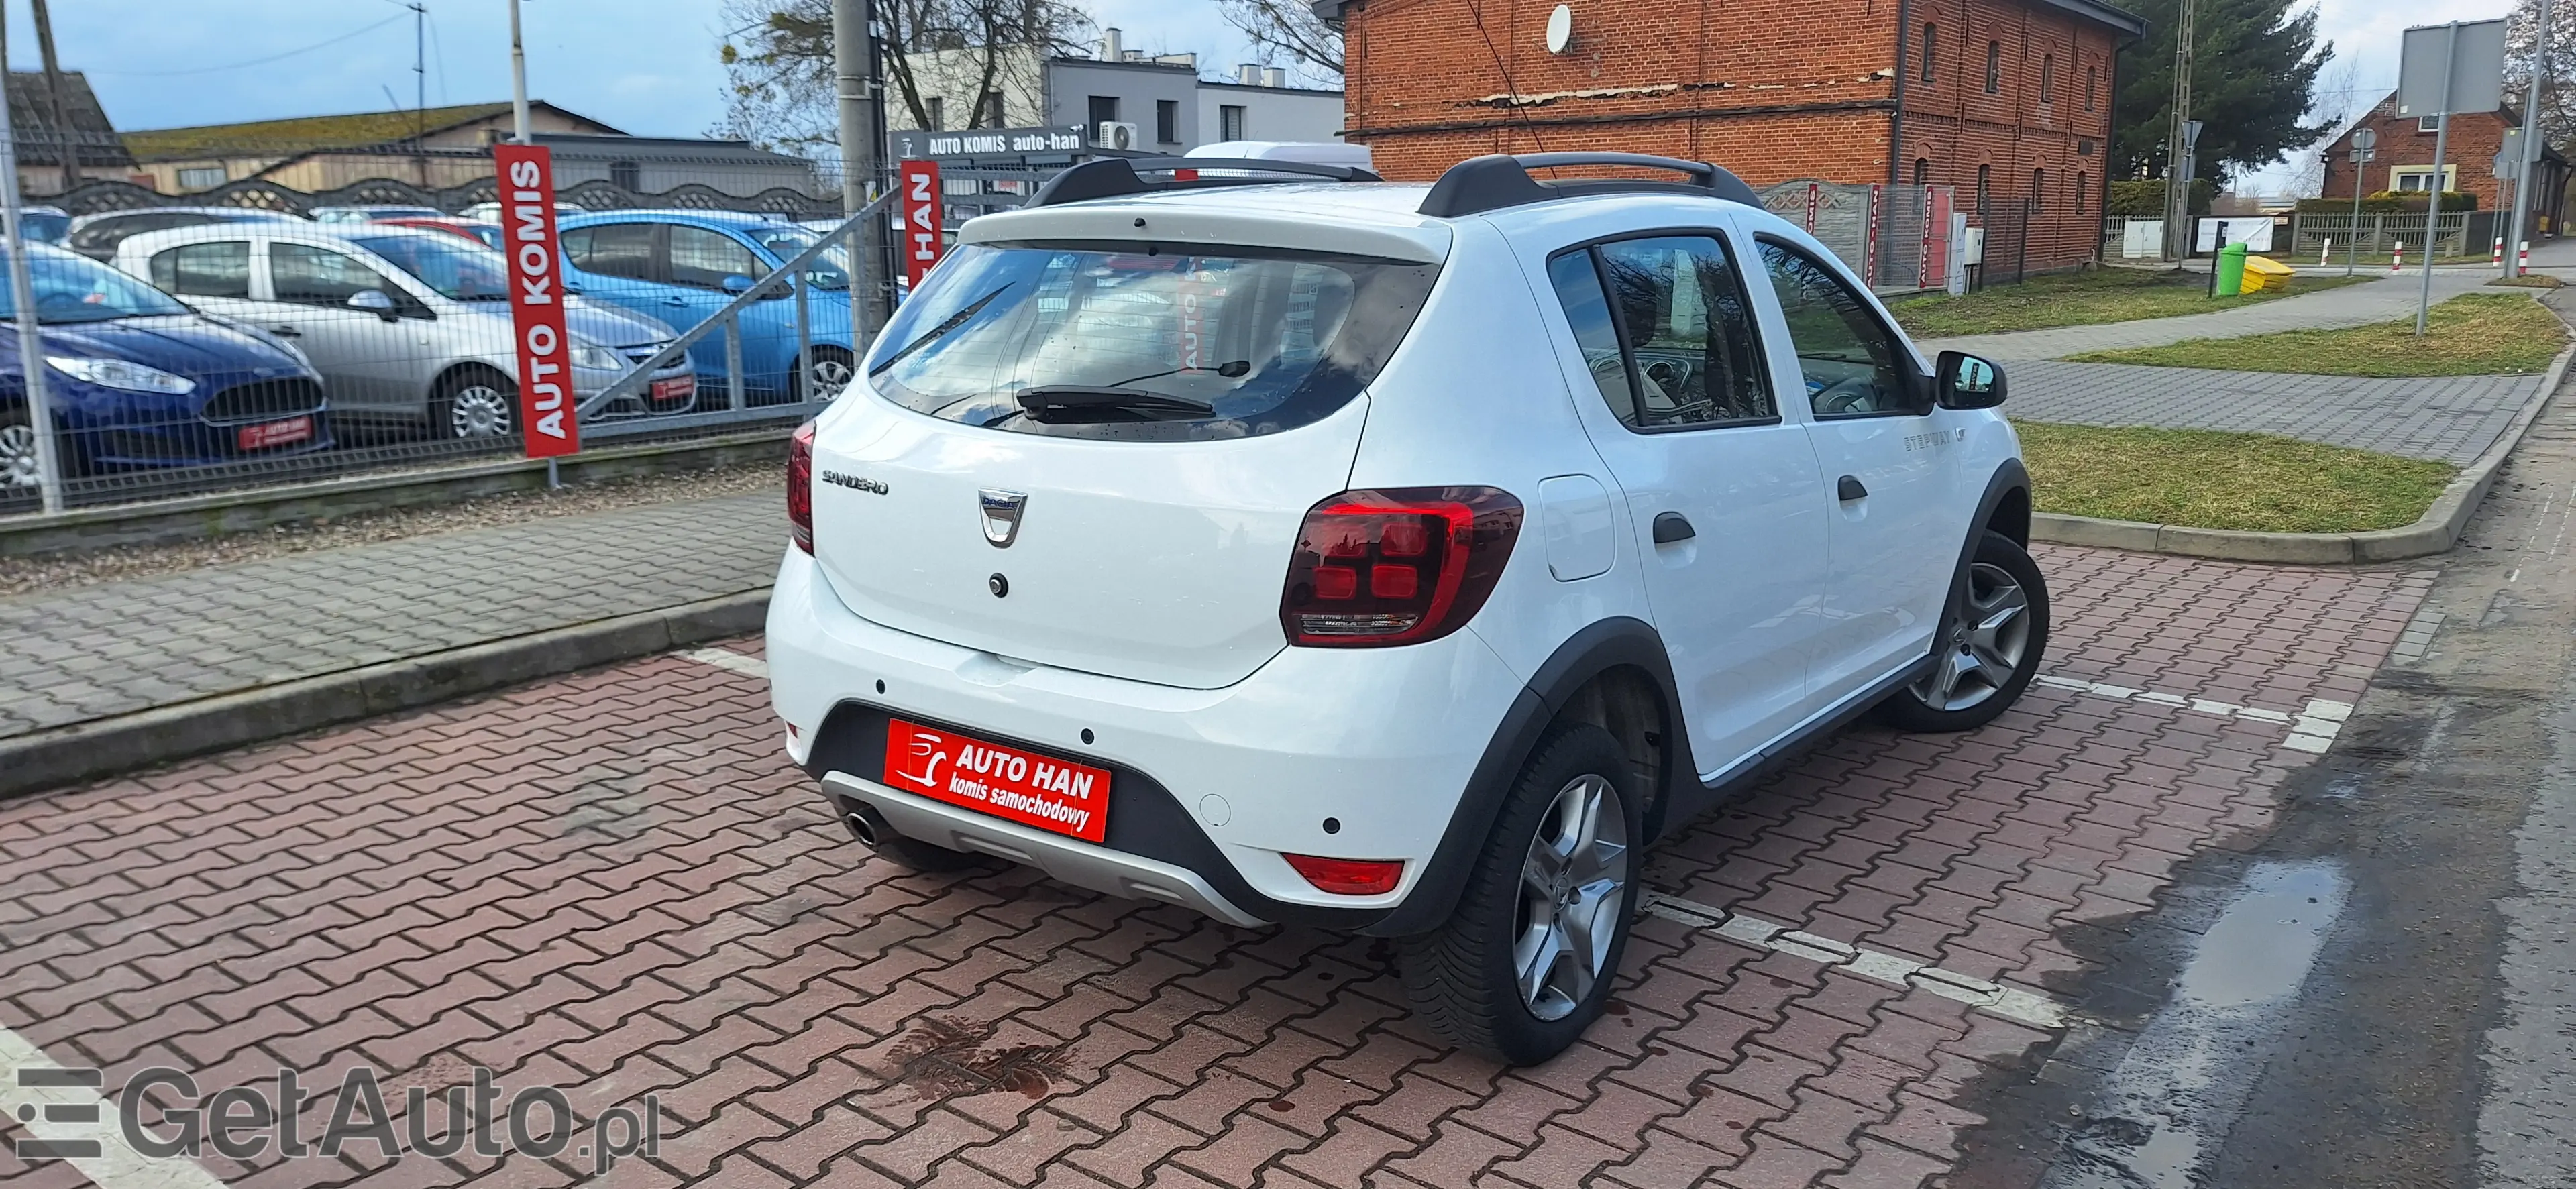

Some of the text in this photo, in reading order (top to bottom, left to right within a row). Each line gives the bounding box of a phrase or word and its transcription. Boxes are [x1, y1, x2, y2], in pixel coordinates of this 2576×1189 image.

[929, 133, 1080, 155] AUTO KOMIS auto-han
[910, 174, 934, 260] HAN
[1871, 190, 1879, 229] HAN
[1924, 191, 1933, 239] KOMIS
[510, 160, 566, 439] AUTO KOMIS
[1184, 294, 1198, 370] AUTO
[1904, 430, 1950, 452] STEPWAY
[822, 470, 889, 496] SANDERO
[983, 498, 1018, 508] DACIA
[955, 744, 1094, 800] AUTO HAN
[949, 771, 1091, 832] komis samochodowy
